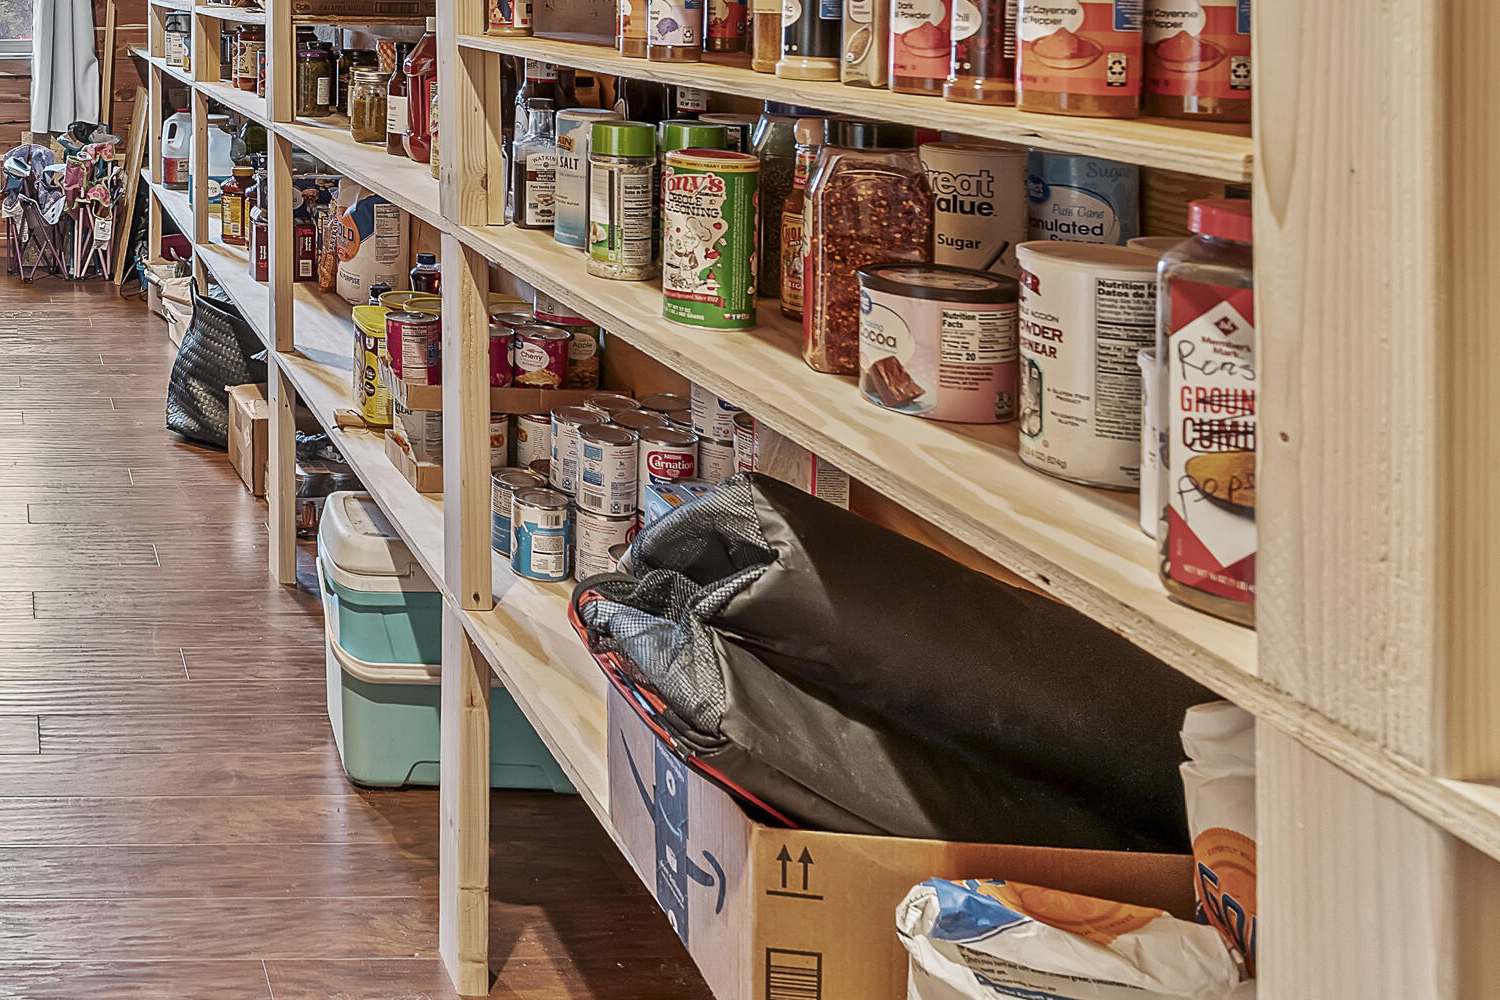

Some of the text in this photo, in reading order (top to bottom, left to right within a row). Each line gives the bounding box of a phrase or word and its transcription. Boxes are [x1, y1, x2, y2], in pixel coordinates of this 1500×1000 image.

[901, 11, 931, 20] Powder
[1033, 5, 1078, 16] Cayenne
[1155, 8, 1199, 20] Cayenne
[1030, 17, 1063, 27] Pepper
[560, 156, 580, 171] SALT
[923, 160, 995, 198] reat
[933, 193, 996, 217] alue
[1052, 203, 1105, 219] Pure Cane
[937, 233, 982, 250] Sugar
[1098, 279, 1146, 291] Nutrition
[1098, 288, 1130, 299] Datos
[1132, 290, 1145, 299] de
[942, 311, 977, 321] Nutrition
[942, 319, 964, 329] Facts
[573, 341, 594, 350] Apple
[520, 349, 544, 362] Cherry
[965, 353, 976, 361] 20
[649, 454, 694, 470] Carnation
